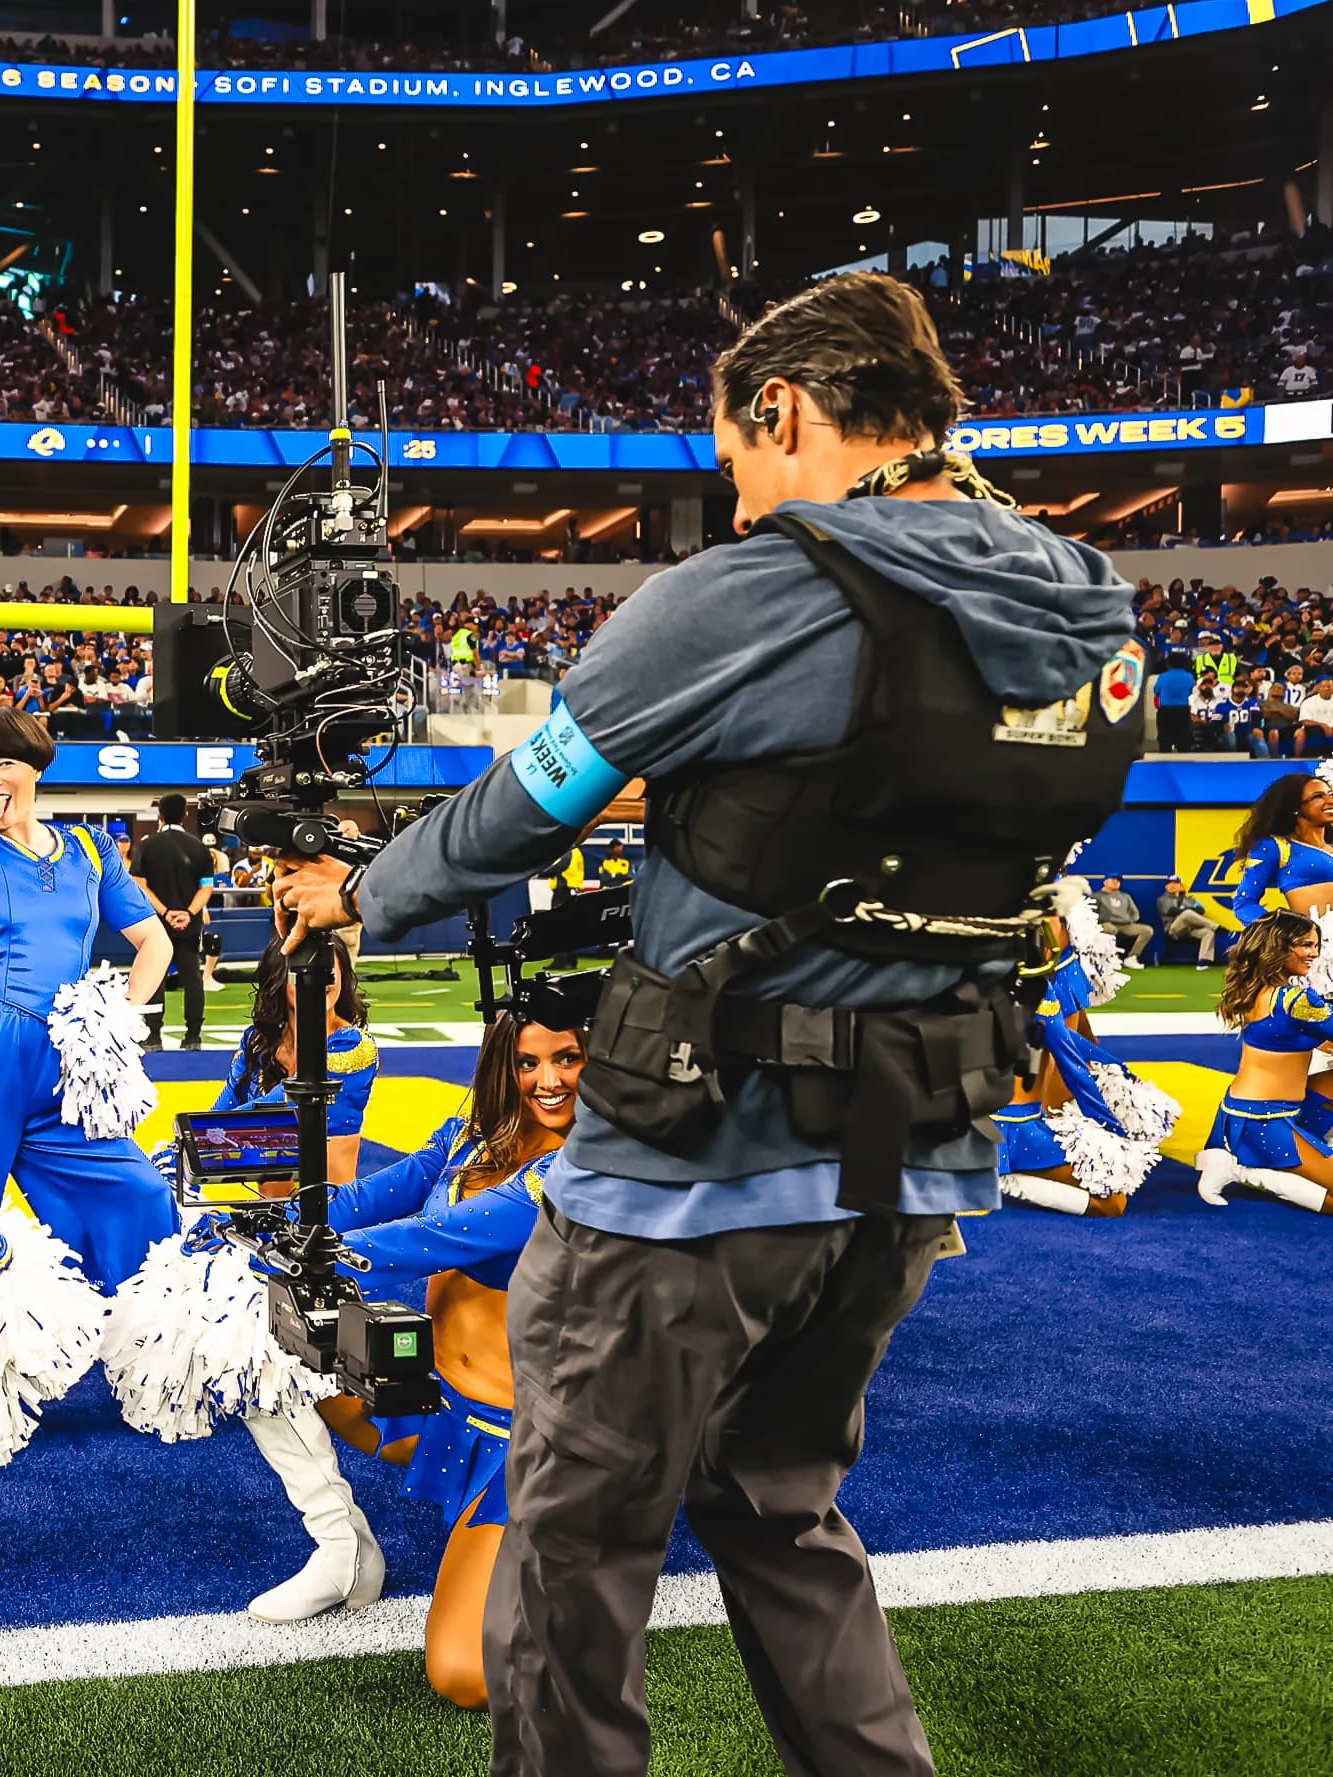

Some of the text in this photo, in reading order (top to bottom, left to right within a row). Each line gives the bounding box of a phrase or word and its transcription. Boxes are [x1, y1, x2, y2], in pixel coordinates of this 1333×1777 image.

[37, 71, 176, 93] SEASON
[214, 75, 290, 95] SOFI
[710, 61, 756, 82] CA
[1075, 417, 1208, 445] WEEK
[1214, 415, 1246, 439] 5
[531, 738, 569, 790] WEEK
